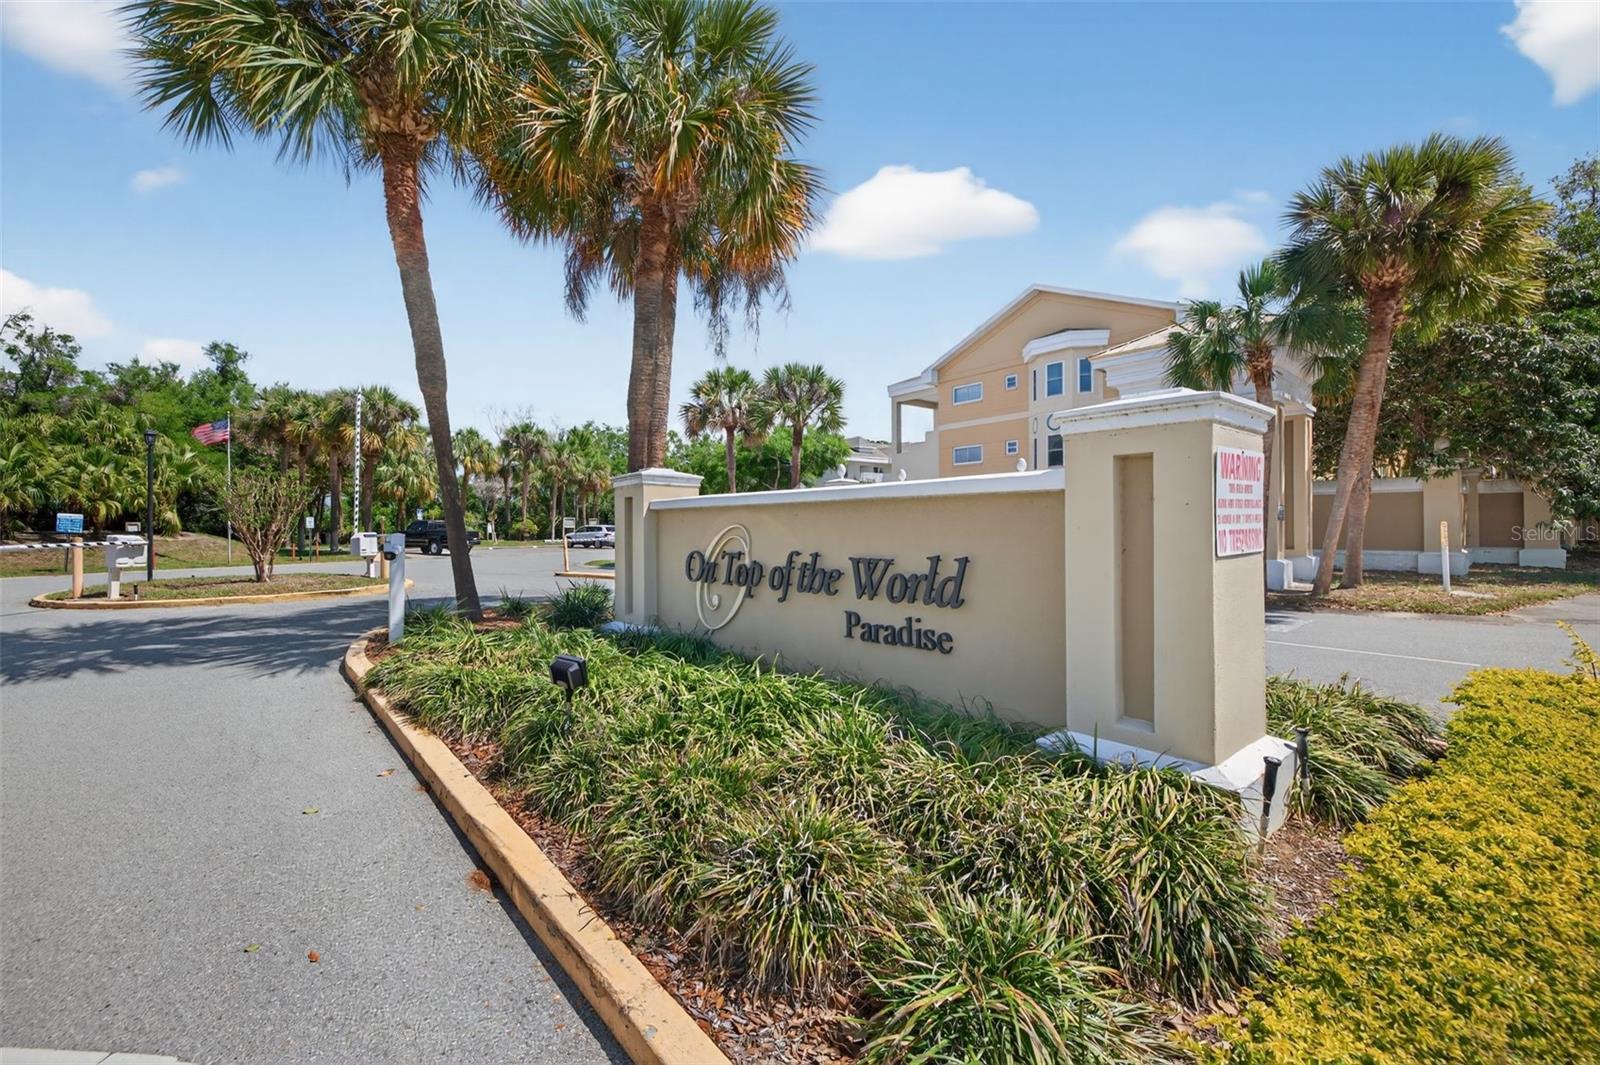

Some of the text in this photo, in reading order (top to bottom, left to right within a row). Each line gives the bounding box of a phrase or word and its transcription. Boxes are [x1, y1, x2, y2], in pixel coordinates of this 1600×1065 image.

[1220, 451, 1261, 482] WARNING
[685, 550, 970, 609] On Top of the World
[844, 610, 953, 655] Paradise
